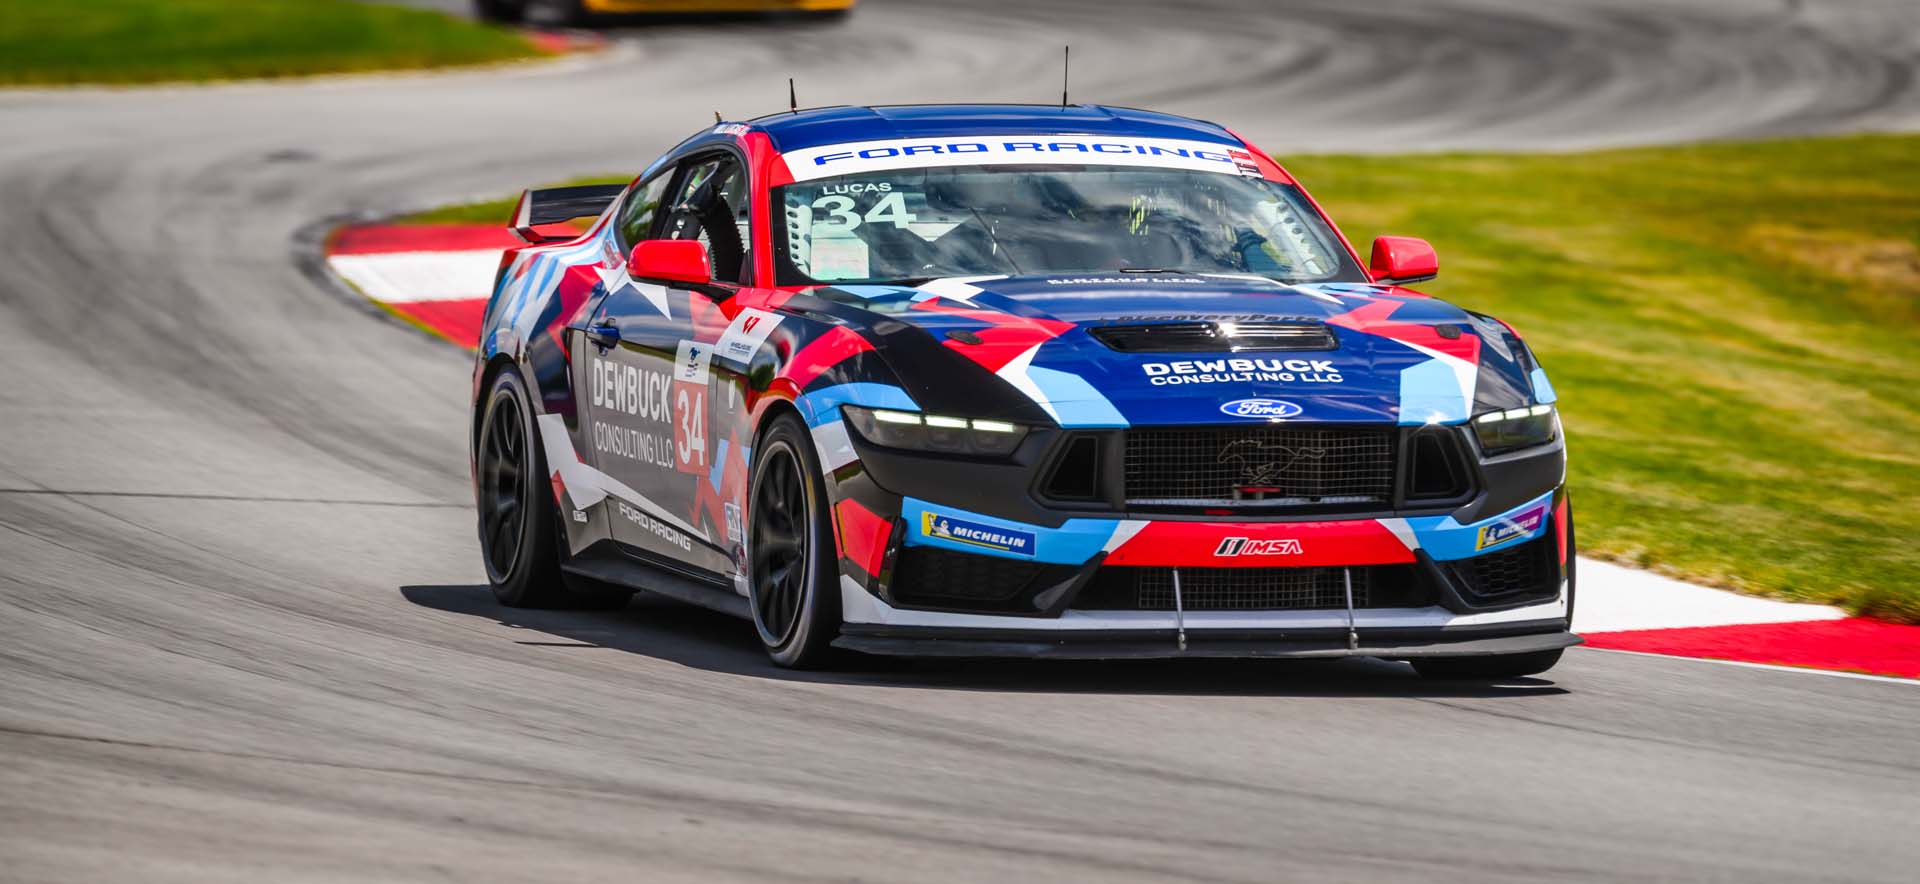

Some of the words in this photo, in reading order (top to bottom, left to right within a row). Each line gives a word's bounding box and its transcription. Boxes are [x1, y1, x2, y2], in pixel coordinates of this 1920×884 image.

[814, 142, 989, 165] FORD
[1005, 142, 1234, 163] RACING
[823, 183, 892, 195] LUCAS
[811, 192, 917, 231] 34
[1142, 359, 1339, 376] DEWBUCK
[1150, 373, 1295, 385] CONSULTING
[1299, 373, 1344, 383] LLC
[593, 358, 672, 424] DEWBUCK
[1236, 401, 1288, 415] Ford
[677, 389, 705, 466] 34
[594, 421, 654, 463] CONSULTING
[654, 435, 674, 469] LLC
[619, 502, 649, 530] FORD
[650, 518, 691, 552] RACING
[953, 526, 1026, 548] MICHELIN
[1240, 538, 1304, 556] IMSA
